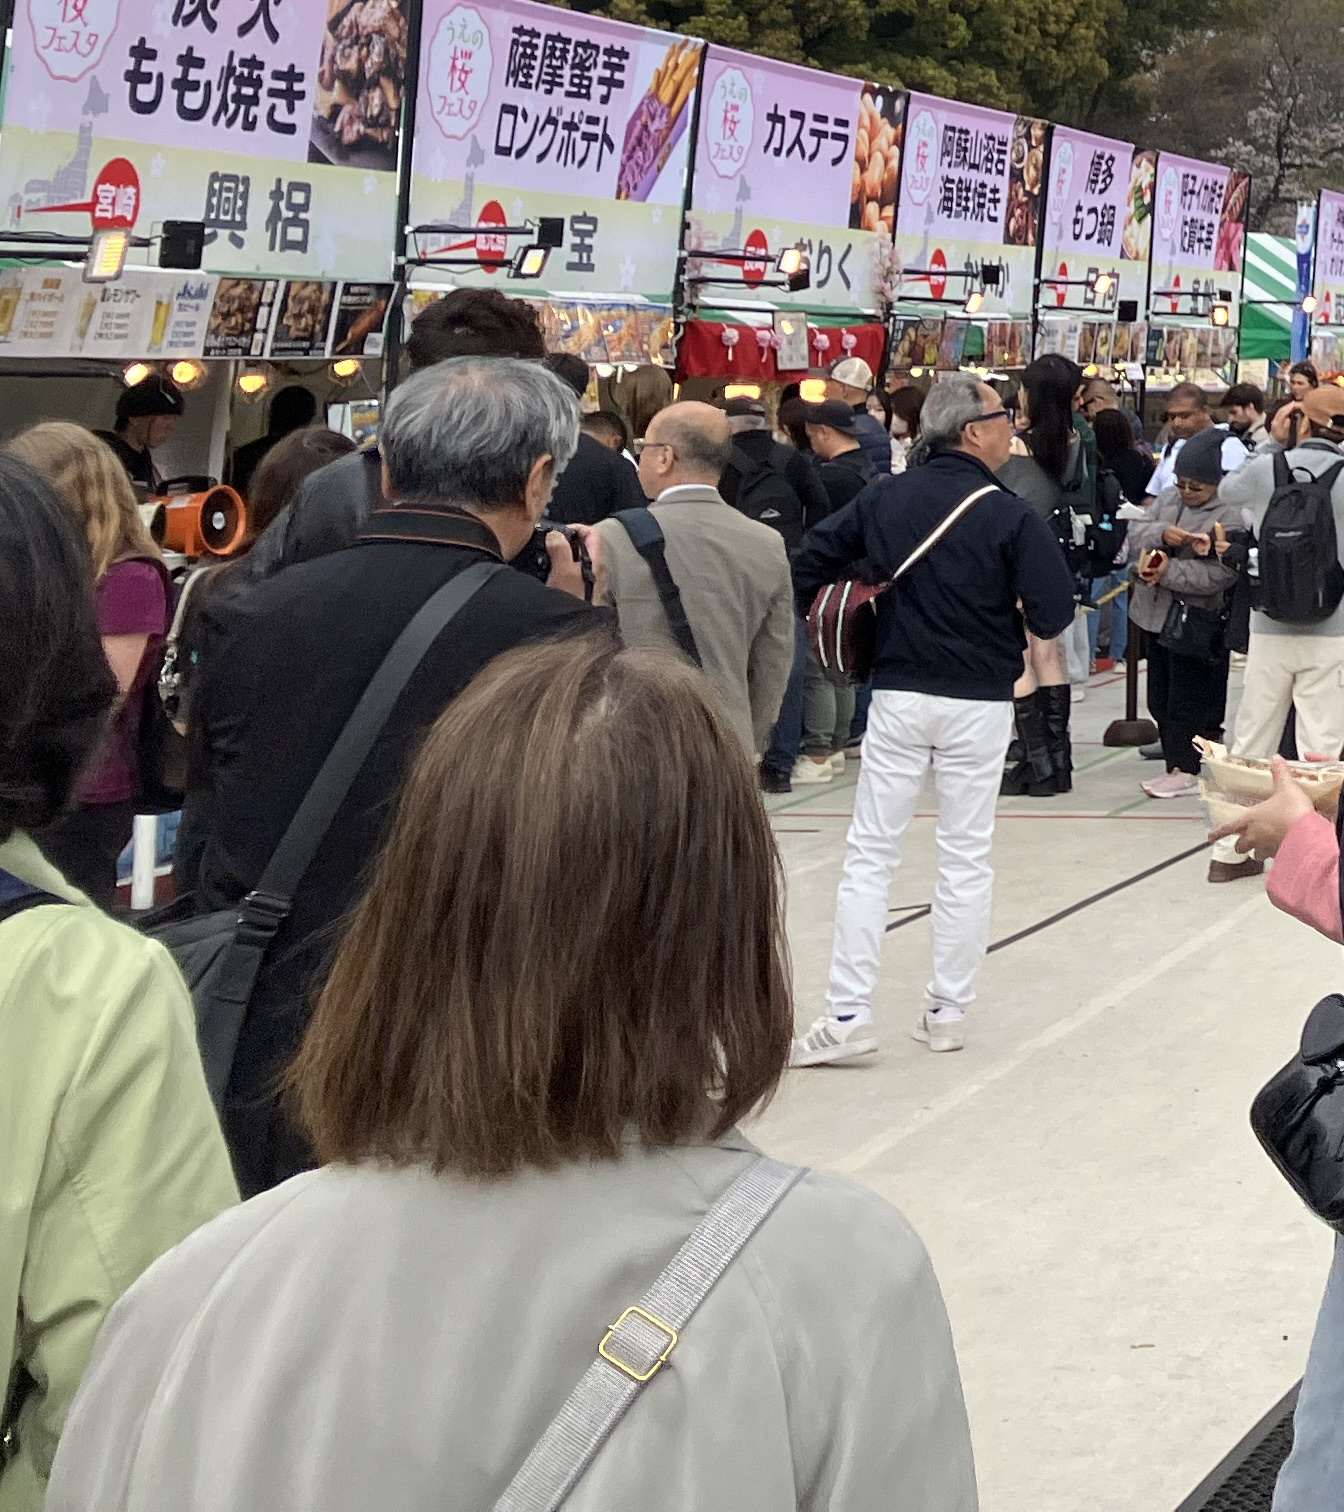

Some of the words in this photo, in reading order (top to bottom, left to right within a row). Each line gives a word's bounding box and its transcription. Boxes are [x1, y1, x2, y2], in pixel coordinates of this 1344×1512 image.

[41, 25, 99, 58] フェスタ
[446, 17, 483, 51] うえの
[123, 37, 306, 136] もも焼き
[449, 46, 475, 96] 桜
[505, 24, 630, 106] 薩摩蜜芋
[436, 95, 477, 121] フェスタ
[721, 100, 741, 143] 桜
[494, 102, 615, 173] ロングポテト
[763, 103, 850, 167] カステラ
[939, 123, 1009, 177] 阿蘇山溶岩
[1085, 149, 1116, 196] 博多
[937, 175, 1001, 223] 海鮮焼き
[565, 210, 598, 272] 宝
[1072, 200, 1116, 248] もつ鍋
